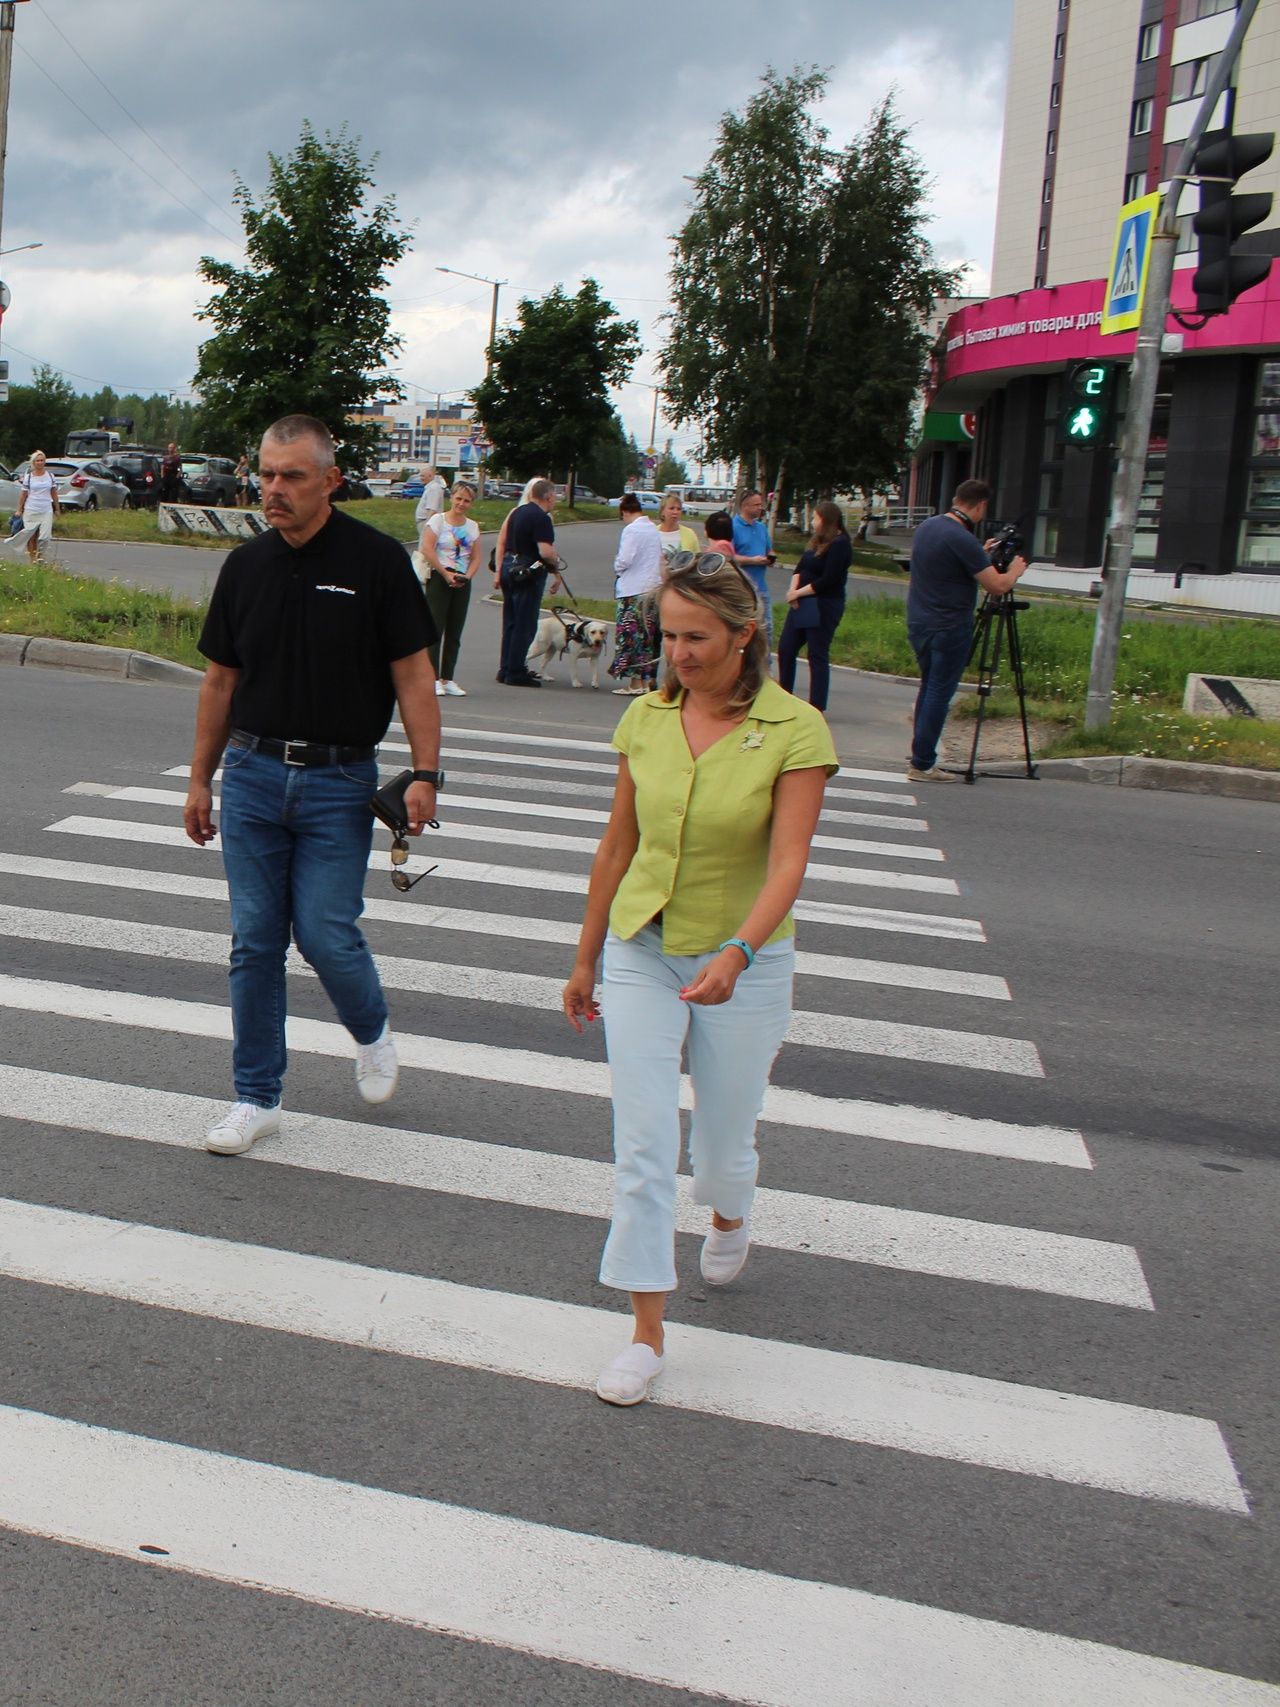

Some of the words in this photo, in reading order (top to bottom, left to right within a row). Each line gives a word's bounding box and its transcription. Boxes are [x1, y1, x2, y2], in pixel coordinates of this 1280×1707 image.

[998, 321, 1026, 338] химия
[1028, 315, 1074, 334] товары
[1076, 311, 1103, 331] для
[1086, 368, 1105, 395] 2
